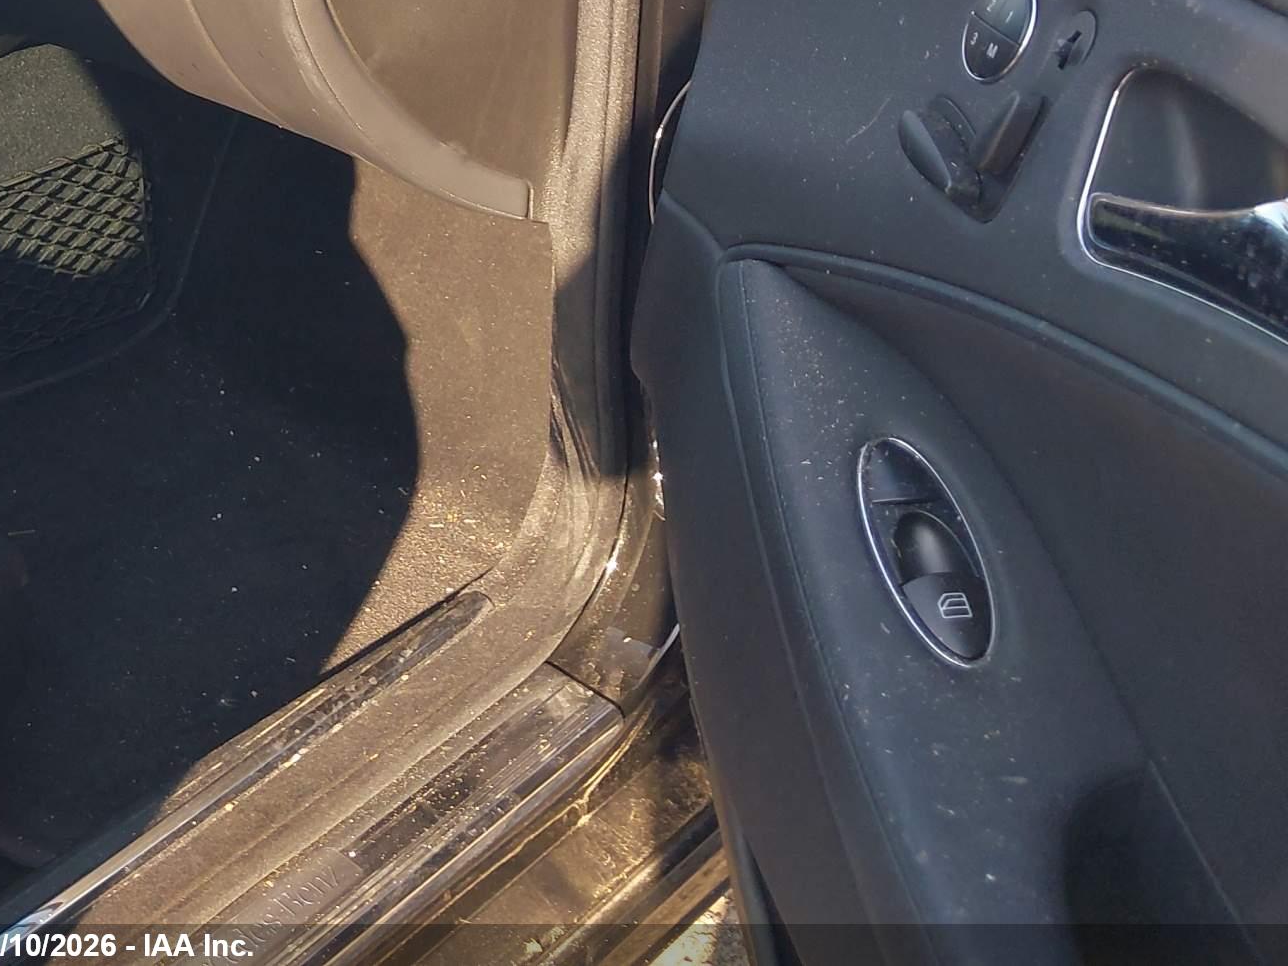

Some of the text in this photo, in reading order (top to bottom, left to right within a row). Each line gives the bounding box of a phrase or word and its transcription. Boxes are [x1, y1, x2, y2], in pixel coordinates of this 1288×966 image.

[1005, 10, 1013, 23] 1
[970, 32, 979, 45] 3
[986, 42, 998, 58] M
